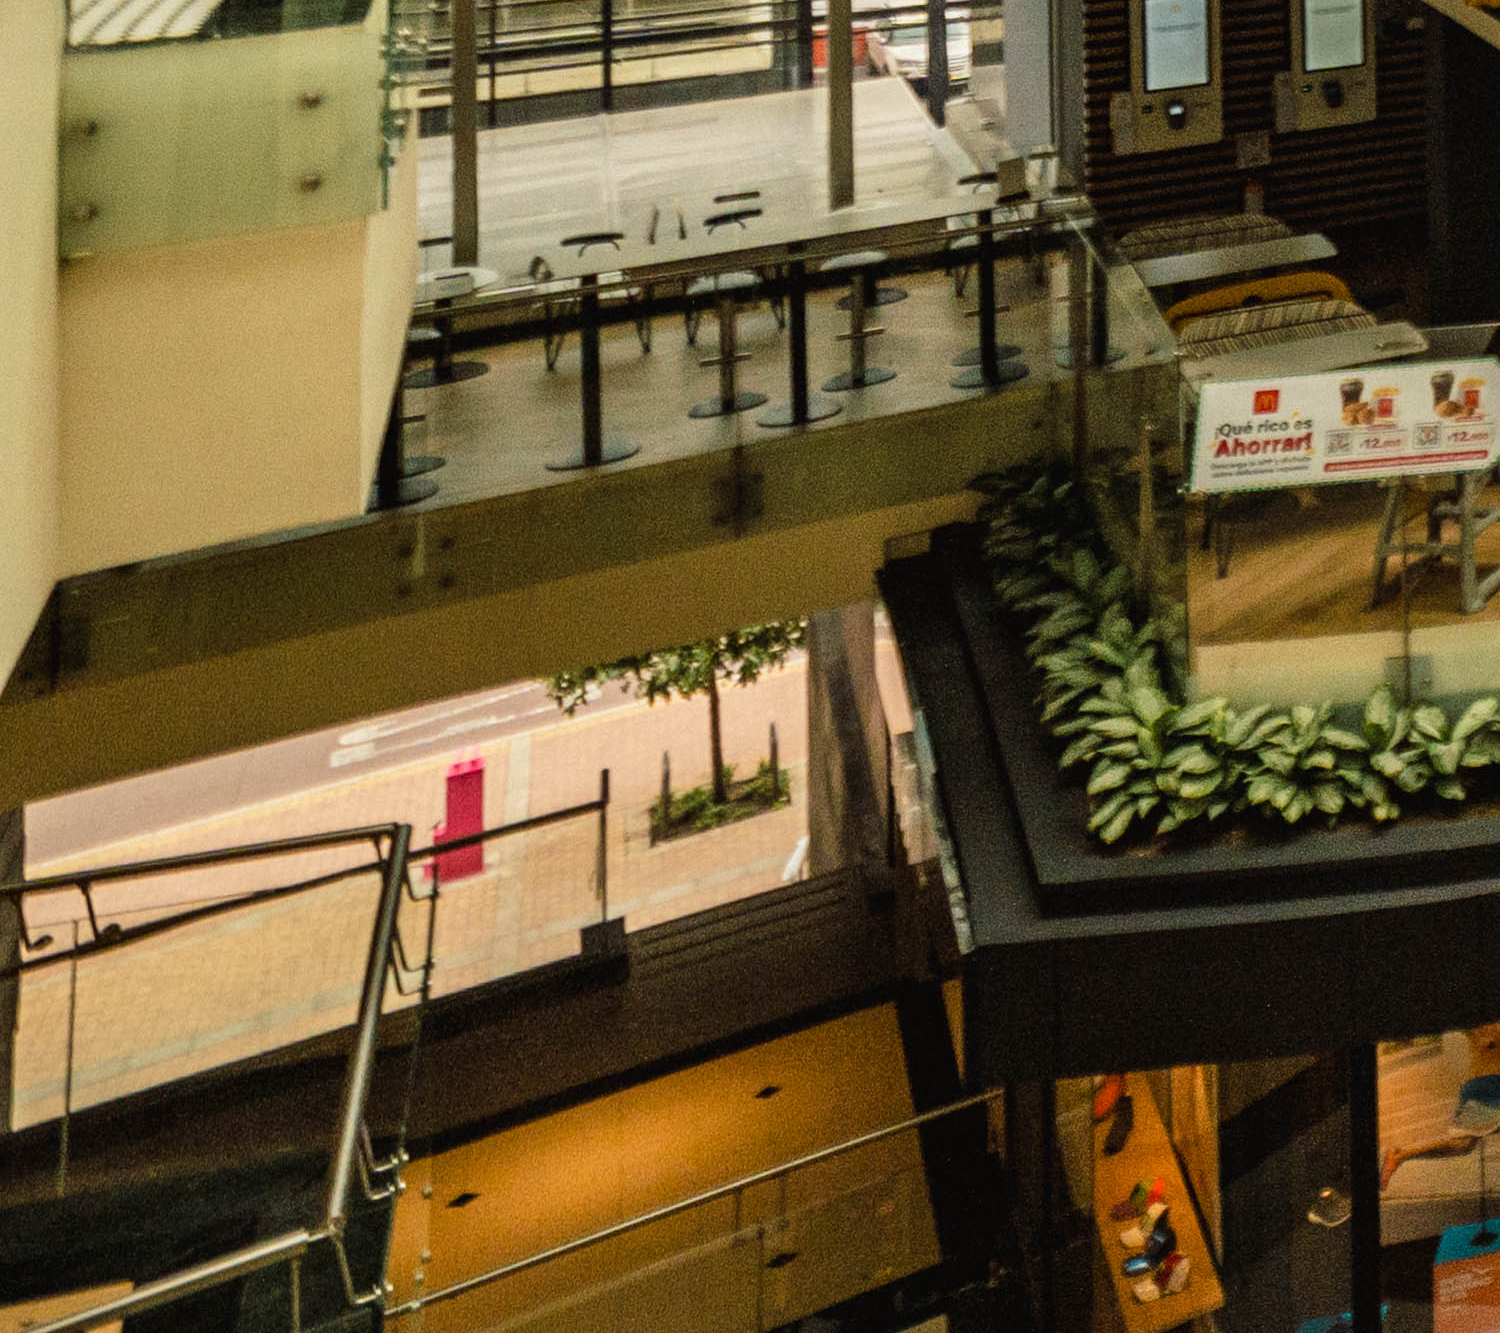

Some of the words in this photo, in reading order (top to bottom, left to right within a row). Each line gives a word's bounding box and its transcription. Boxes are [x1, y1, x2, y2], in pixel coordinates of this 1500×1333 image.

[1257, 419, 1289, 433] rico
[1293, 418, 1313, 430] es
[1213, 431, 1313, 459] Ahorrar!
